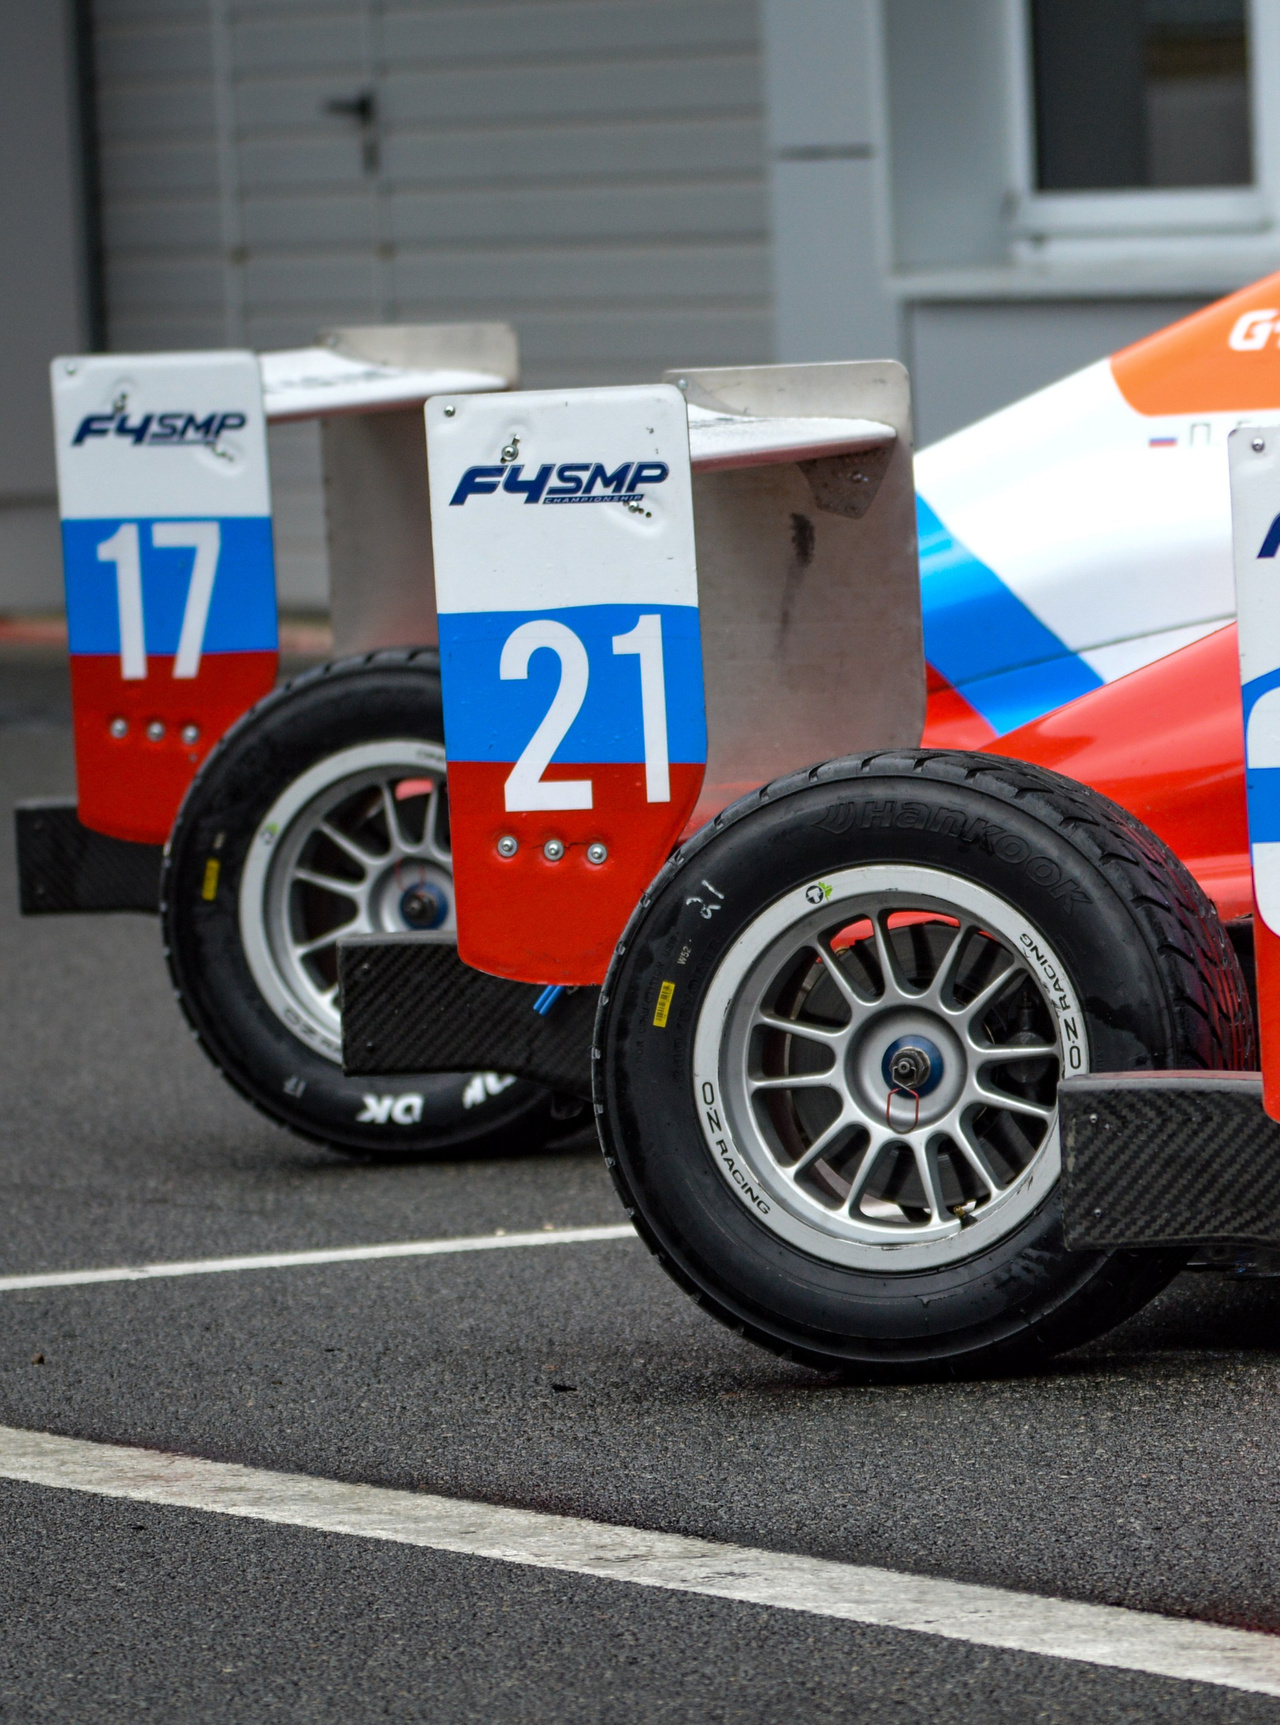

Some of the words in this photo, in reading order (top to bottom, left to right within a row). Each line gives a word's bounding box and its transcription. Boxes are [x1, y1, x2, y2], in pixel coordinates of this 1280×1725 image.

[543, 494, 645, 505] CHAMPIONSHIP
[97, 521, 221, 680] 17
[499, 614, 671, 813] 21
[1019, 933, 1071, 1011] RACING
[716, 1139, 771, 1215] RACING
